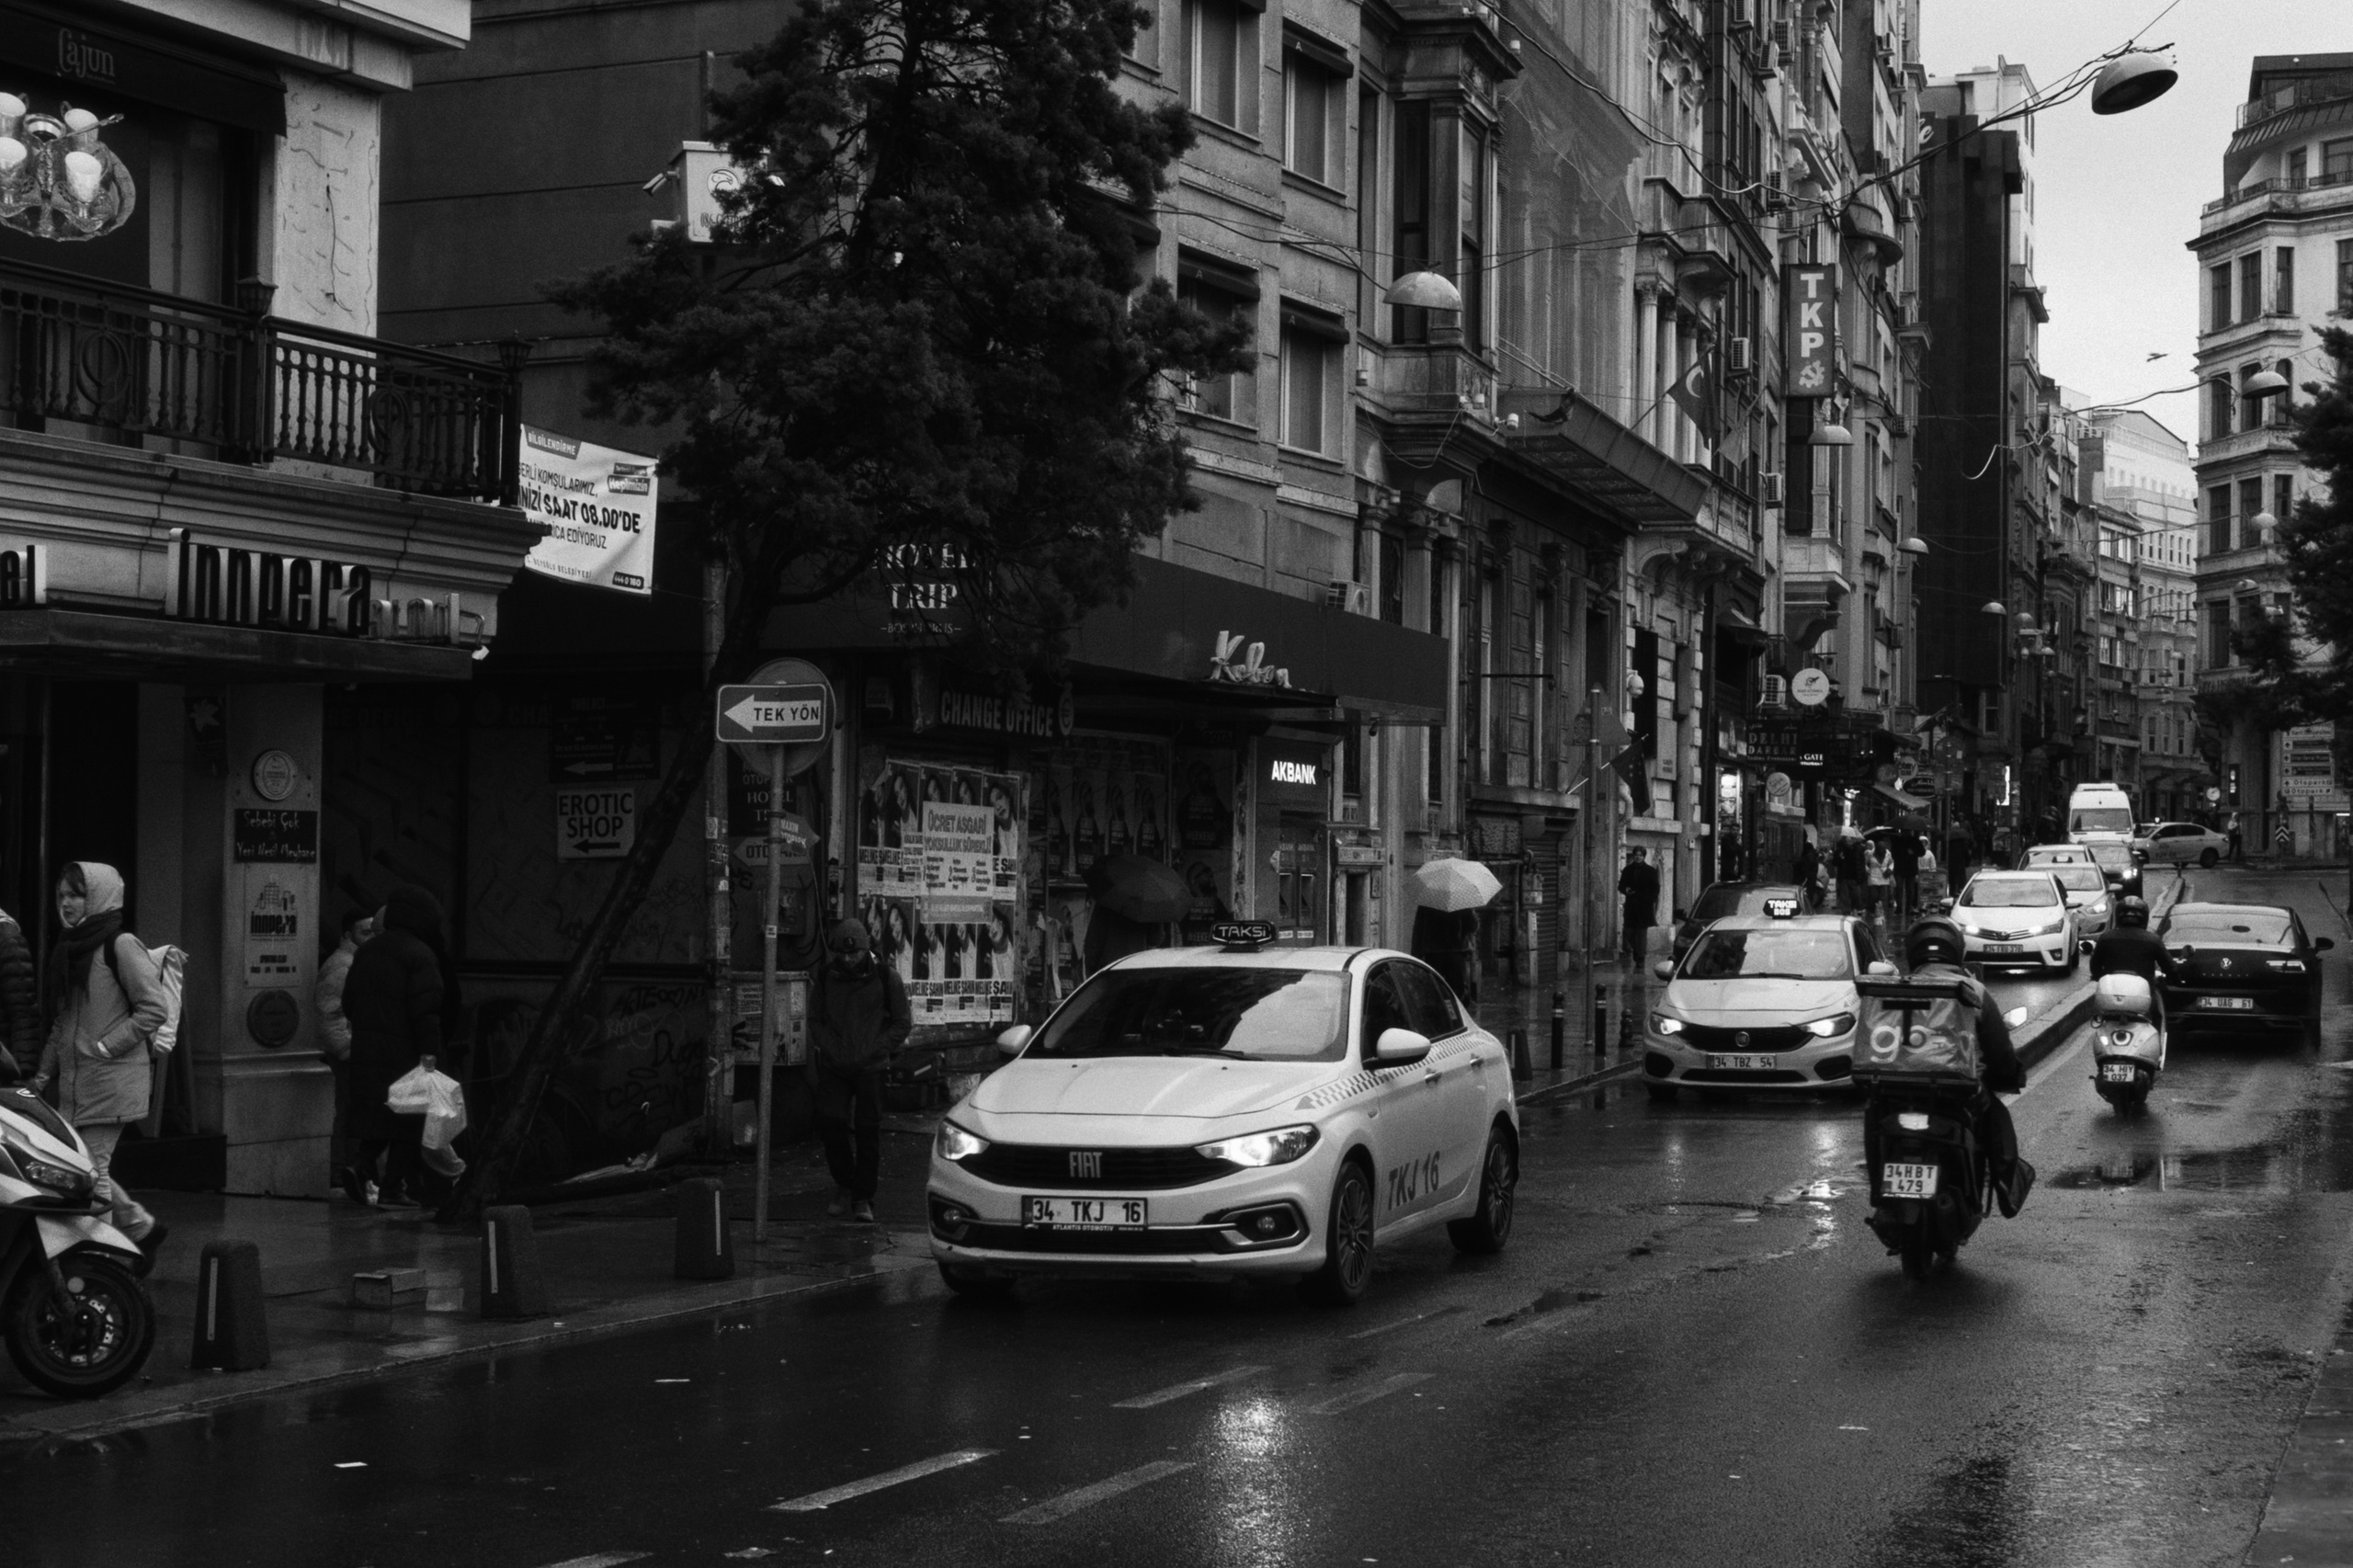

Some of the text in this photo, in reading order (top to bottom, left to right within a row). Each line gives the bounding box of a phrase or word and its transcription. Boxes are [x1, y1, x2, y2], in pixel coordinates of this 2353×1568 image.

[59, 28, 115, 78] Cajun
[1800, 272, 1825, 358] TKP
[543, 493, 578, 521] SAAT
[580, 502, 642, 534] 08.00'DE
[567, 526, 608, 550] EDİYORUZ
[167, 528, 370, 638] innpera
[885, 583, 959, 609] TRIP
[754, 703, 820, 722] TEK YÖN
[940, 690, 1054, 738] CHANGE OFFICE
[1748, 733, 1798, 745] DELHI
[1748, 745, 1797, 756] DARBAR
[1803, 753, 1824, 761] GATE
[1271, 760, 1316, 785] AKBANK
[558, 792, 633, 816] EROTIC
[280, 811, 301, 832] Çok
[567, 815, 624, 838] SHOP
[236, 841, 256, 857] Yeni
[2201, 997, 2251, 1008] 34 UAG 61
[1715, 1057, 1772, 1068] 34 TBZ 54
[2103, 1064, 2115, 1074] 34
[2111, 1074, 2128, 1082] 037
[1069, 1151, 1102, 1178] FIAT
[1388, 1150, 1440, 1210] TKJ 16
[1897, 1180, 1924, 1193] 479
[1033, 1199, 1141, 1223] 34 TKJ 16
